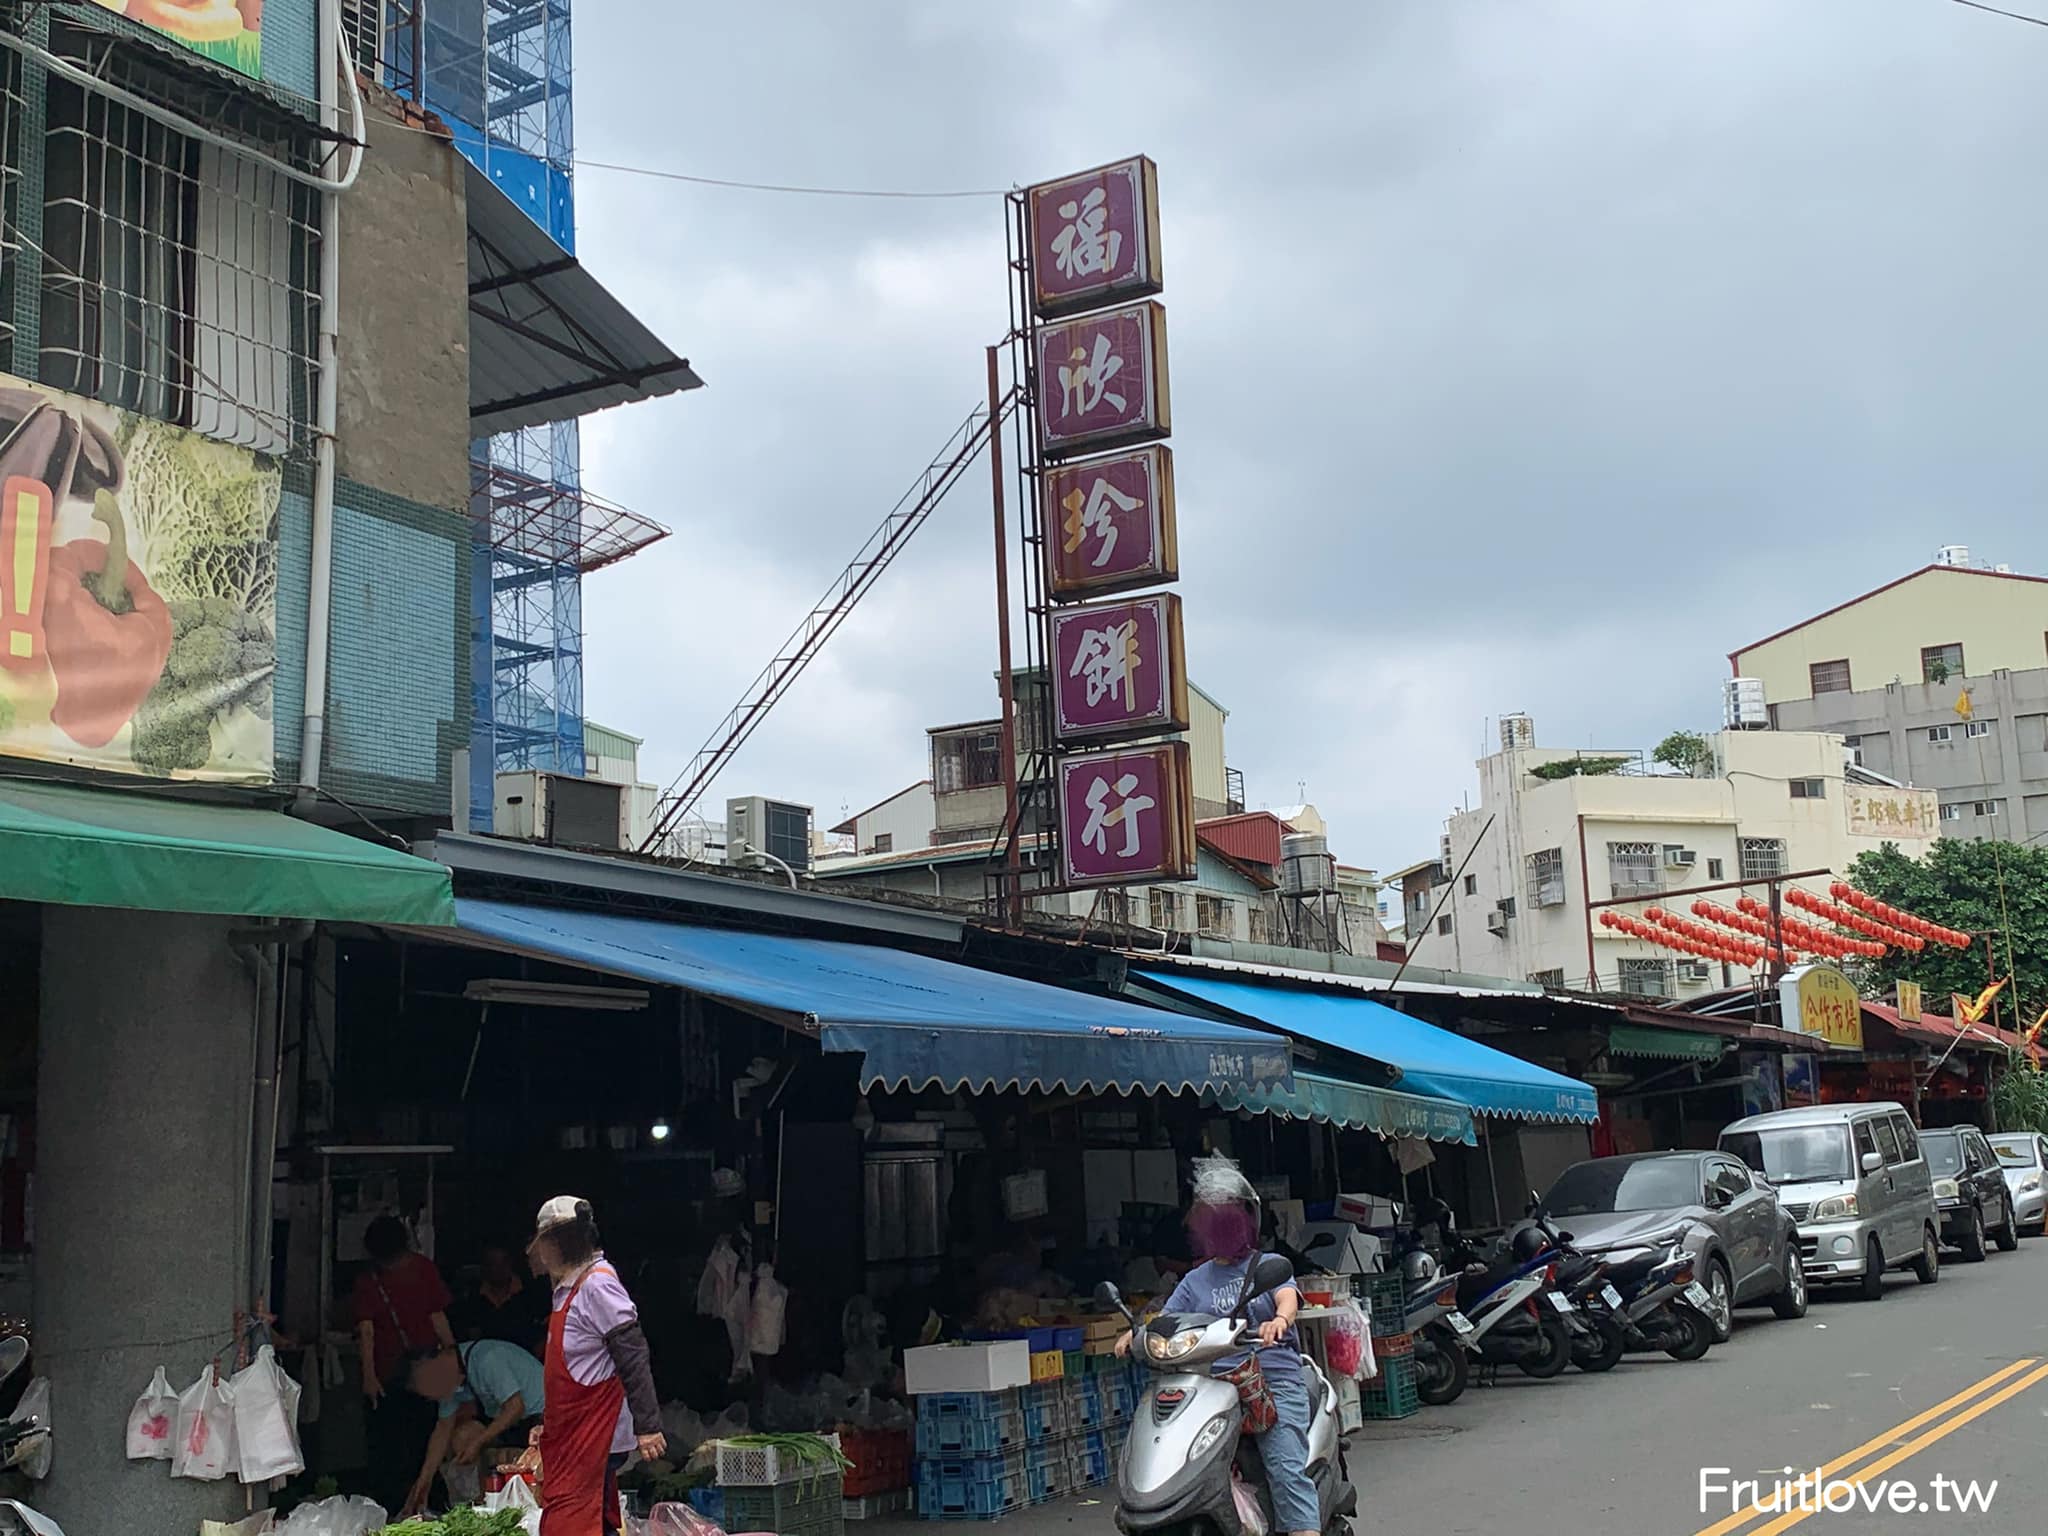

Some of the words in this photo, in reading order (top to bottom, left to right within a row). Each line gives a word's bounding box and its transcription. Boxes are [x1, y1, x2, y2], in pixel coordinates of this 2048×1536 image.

[1051, 187, 1155, 857] 福欣珍餅行
[1850, 798, 1936, 832] 三郎機車行
